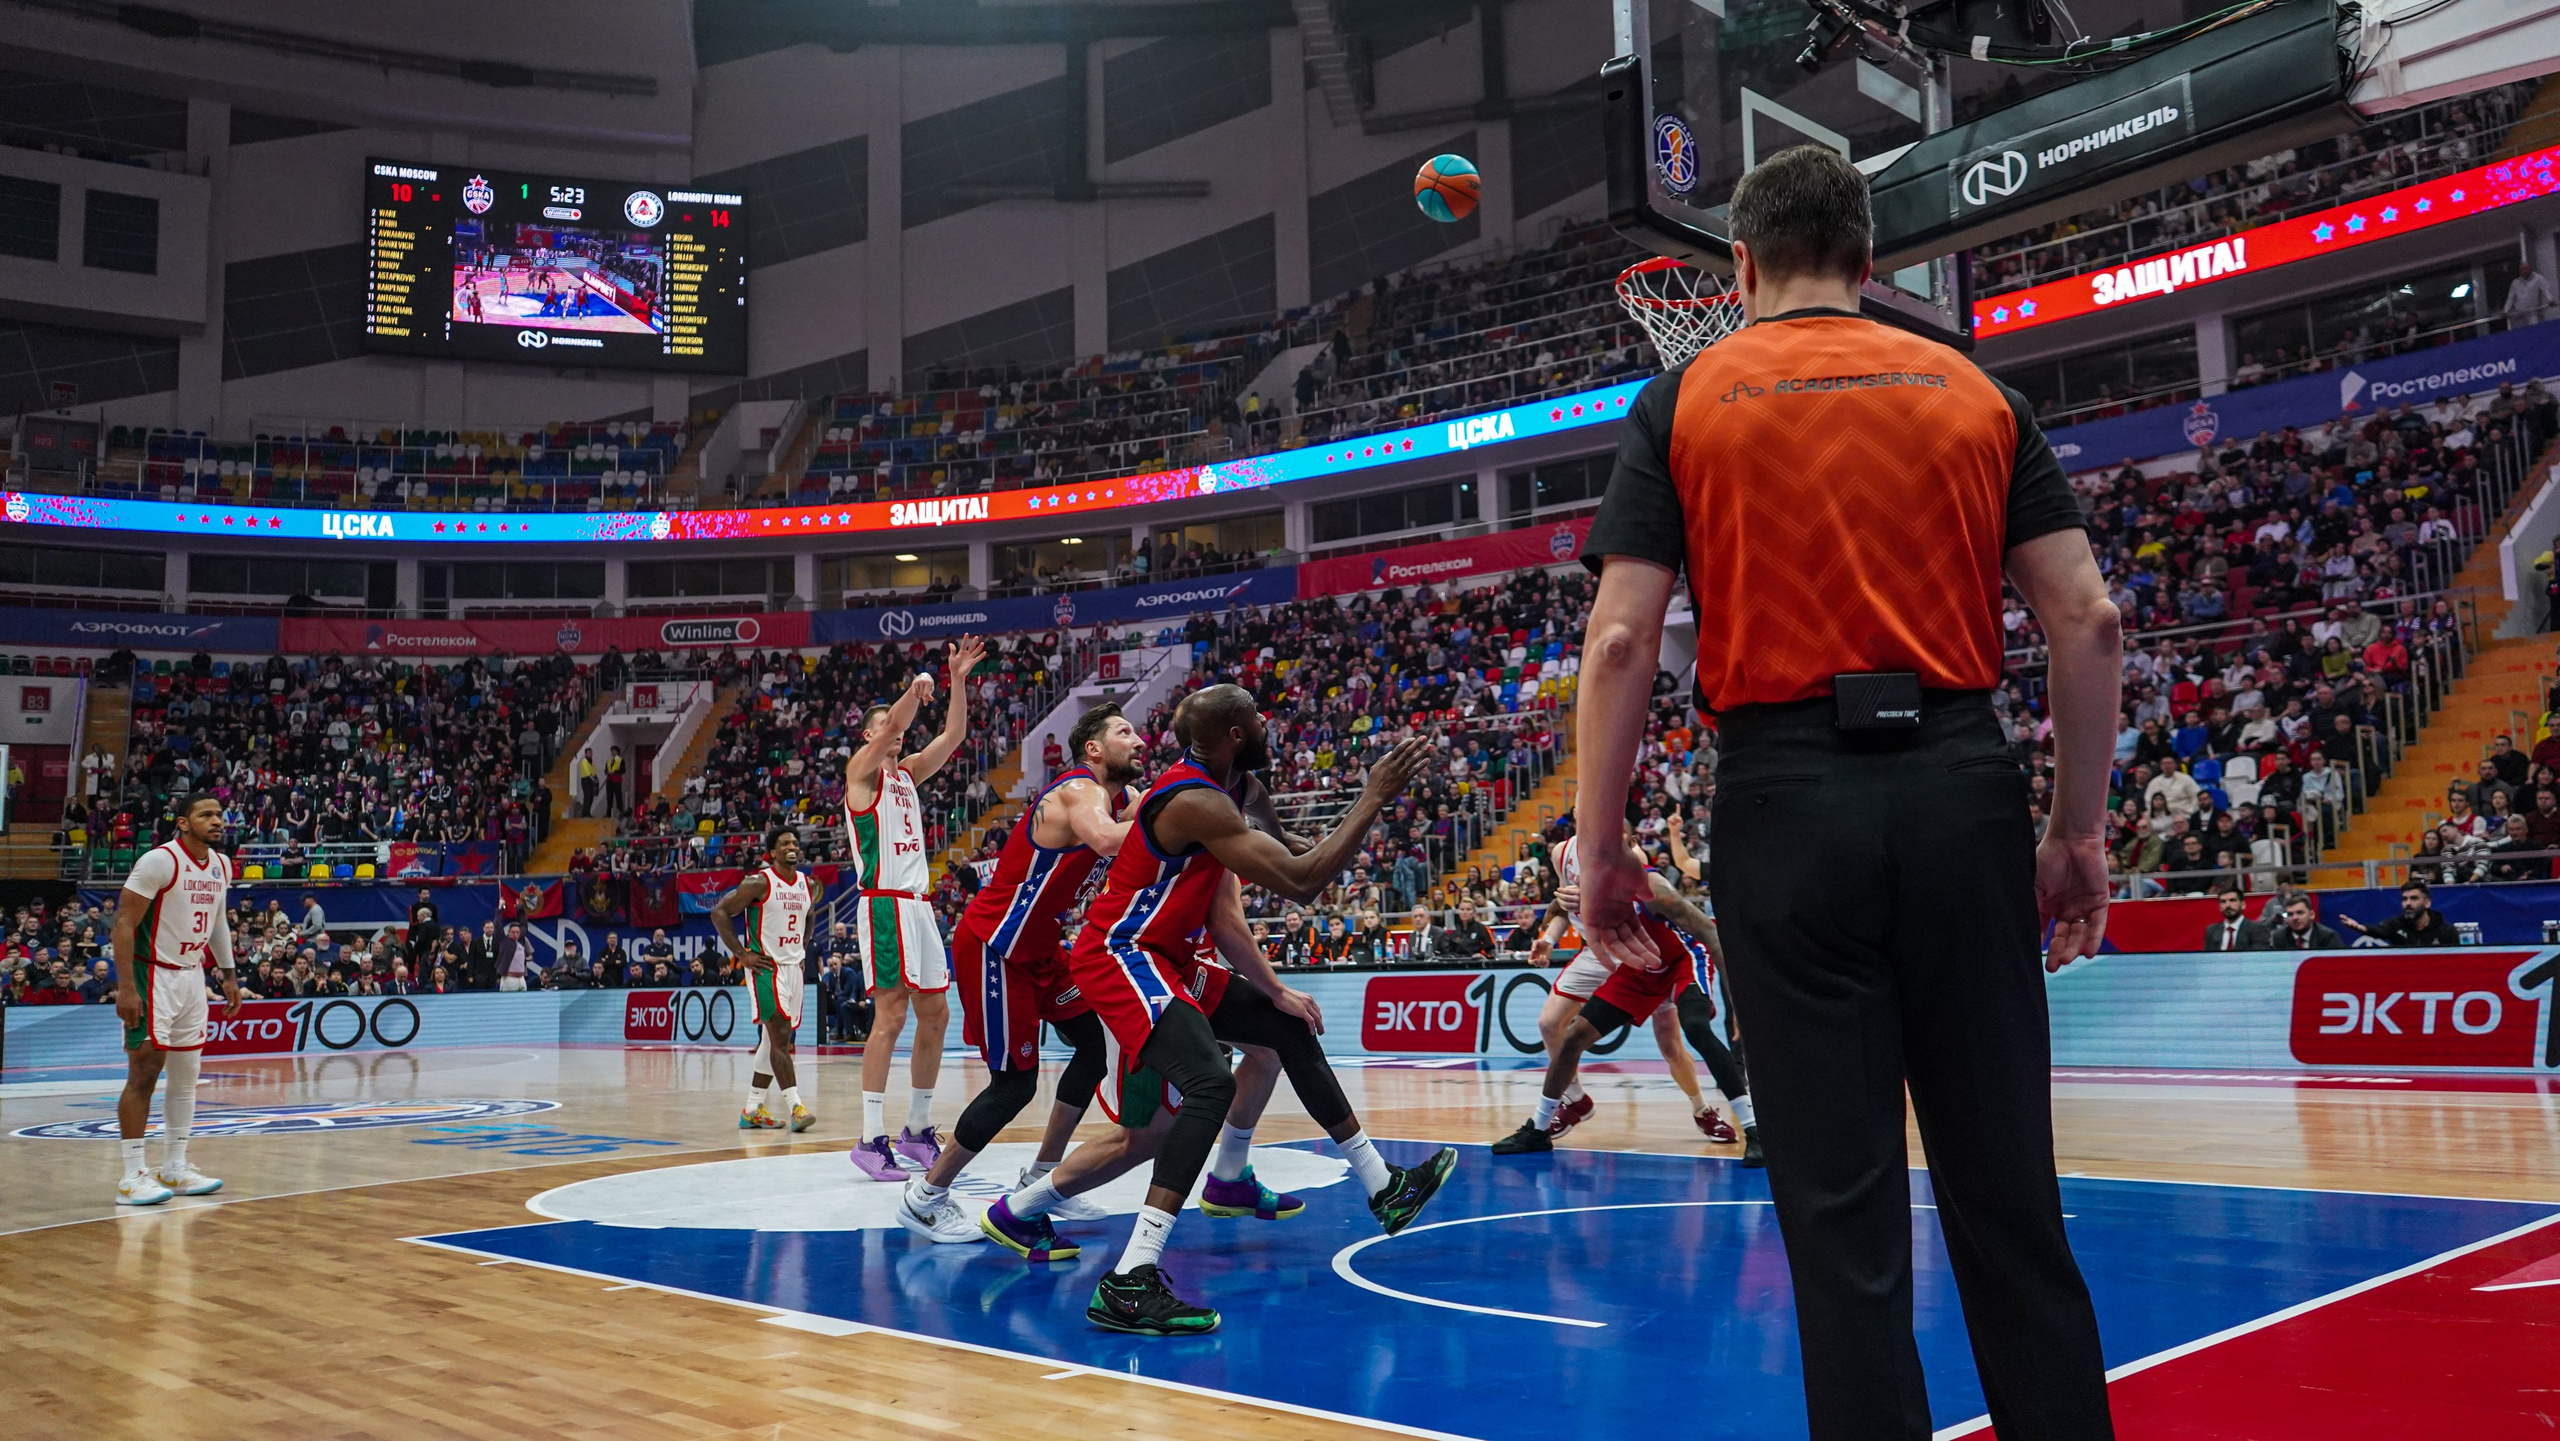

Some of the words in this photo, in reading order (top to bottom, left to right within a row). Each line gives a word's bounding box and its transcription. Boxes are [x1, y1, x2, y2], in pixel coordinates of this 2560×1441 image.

[2038, 106, 2179, 169] НОРНИКЕЛЬ
[374, 165, 397, 177] CSKA
[399, 167, 438, 181] MOSCOW
[391, 183, 412, 202] 10
[467, 190, 489, 200] CSKA
[521, 184, 528, 199] 1
[551, 186, 584, 204] 5:23
[668, 191, 713, 204] LOKOMOTIV
[714, 193, 742, 205] KUBAN
[379, 209, 397, 218] WARE
[711, 210, 730, 228] 14
[2091, 237, 2247, 305] ЗАЩИТА!
[367, 315, 375, 323] 24
[366, 326, 374, 334] 41
[551, 336, 604, 347] NORNICKEL
[2371, 358, 2517, 402] Ростелеком
[1447, 412, 1515, 450] ЦСКА
[890, 496, 989, 527] ЗАЩИТА!
[322, 513, 395, 540] ЦСКА
[1389, 556, 1473, 579] Ростелеком
[1135, 587, 1227, 608] АЭРОФЛОТ
[920, 612, 987, 627] НОРНИКЕЛЬ
[70, 621, 190, 637] АЭРОФЛОТ
[670, 620, 732, 640] Winline
[387, 634, 477, 647] Ростелеком
[191, 893, 215, 904] KUBAN
[783, 902, 803, 911] KUBAN
[193, 911, 208, 933] 31
[788, 914, 797, 931] 2
[630, 1007, 668, 1028] ЭКТО
[669, 989, 736, 1042] 100
[1375, 1000, 1463, 1031] ЭКТО
[2319, 991, 2503, 1035] ЭКТО
[290, 998, 421, 1052] 100
